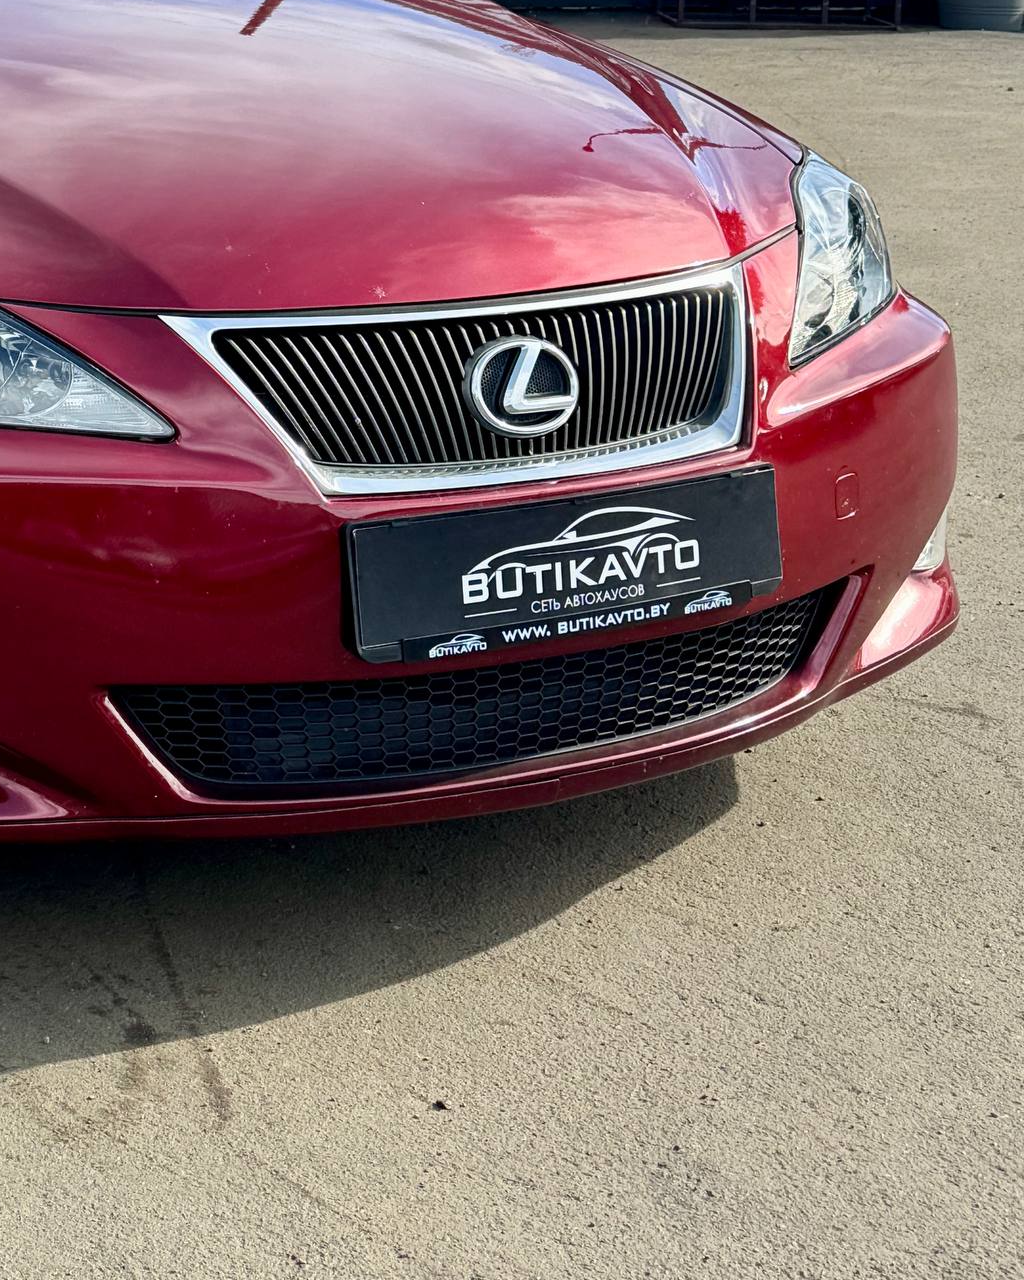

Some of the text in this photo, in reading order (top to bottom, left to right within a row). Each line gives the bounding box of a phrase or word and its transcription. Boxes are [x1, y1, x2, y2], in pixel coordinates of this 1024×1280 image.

[461, 539, 700, 605] BUTIKAVTO
[530, 584, 645, 614] СЕТЬ АВТОХАУСОВ
[684, 597, 732, 615] BUTIKAVTO
[502, 602, 671, 644] WWW. BUTIKAVTO.BY
[428, 641, 488, 659] BUTIKAVTO
